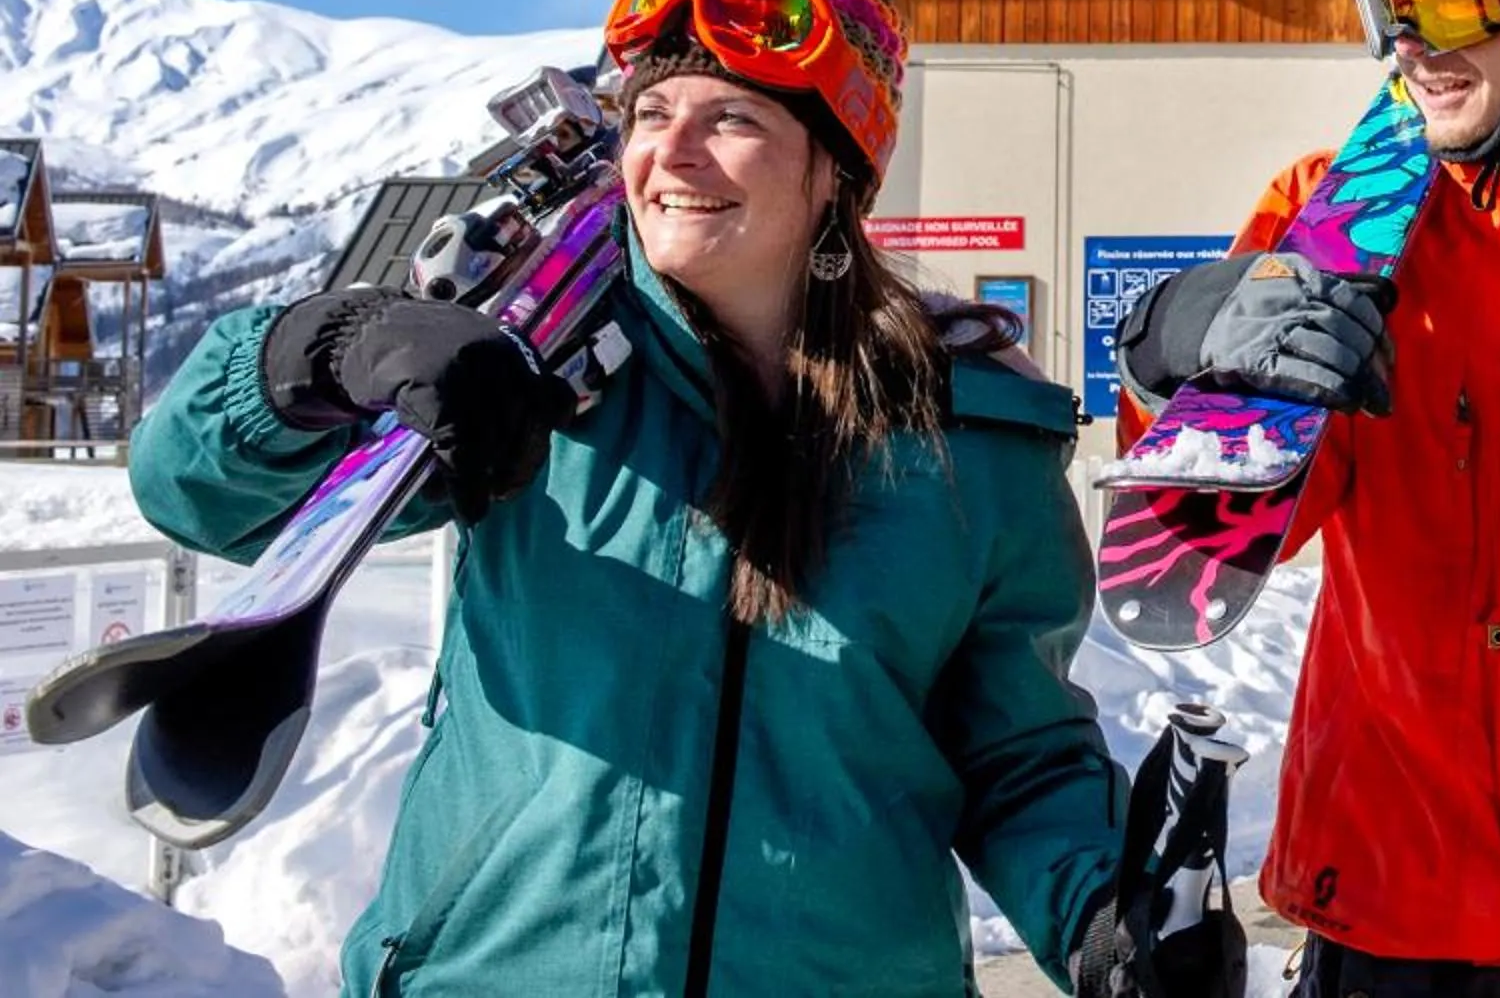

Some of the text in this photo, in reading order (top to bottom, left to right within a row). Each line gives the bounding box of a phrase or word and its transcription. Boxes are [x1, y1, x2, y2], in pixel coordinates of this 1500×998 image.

[924, 221, 949, 232] NON
[883, 235, 1000, 248] UNSUPERVISED POOL
[1176, 251, 1195, 259] aux
